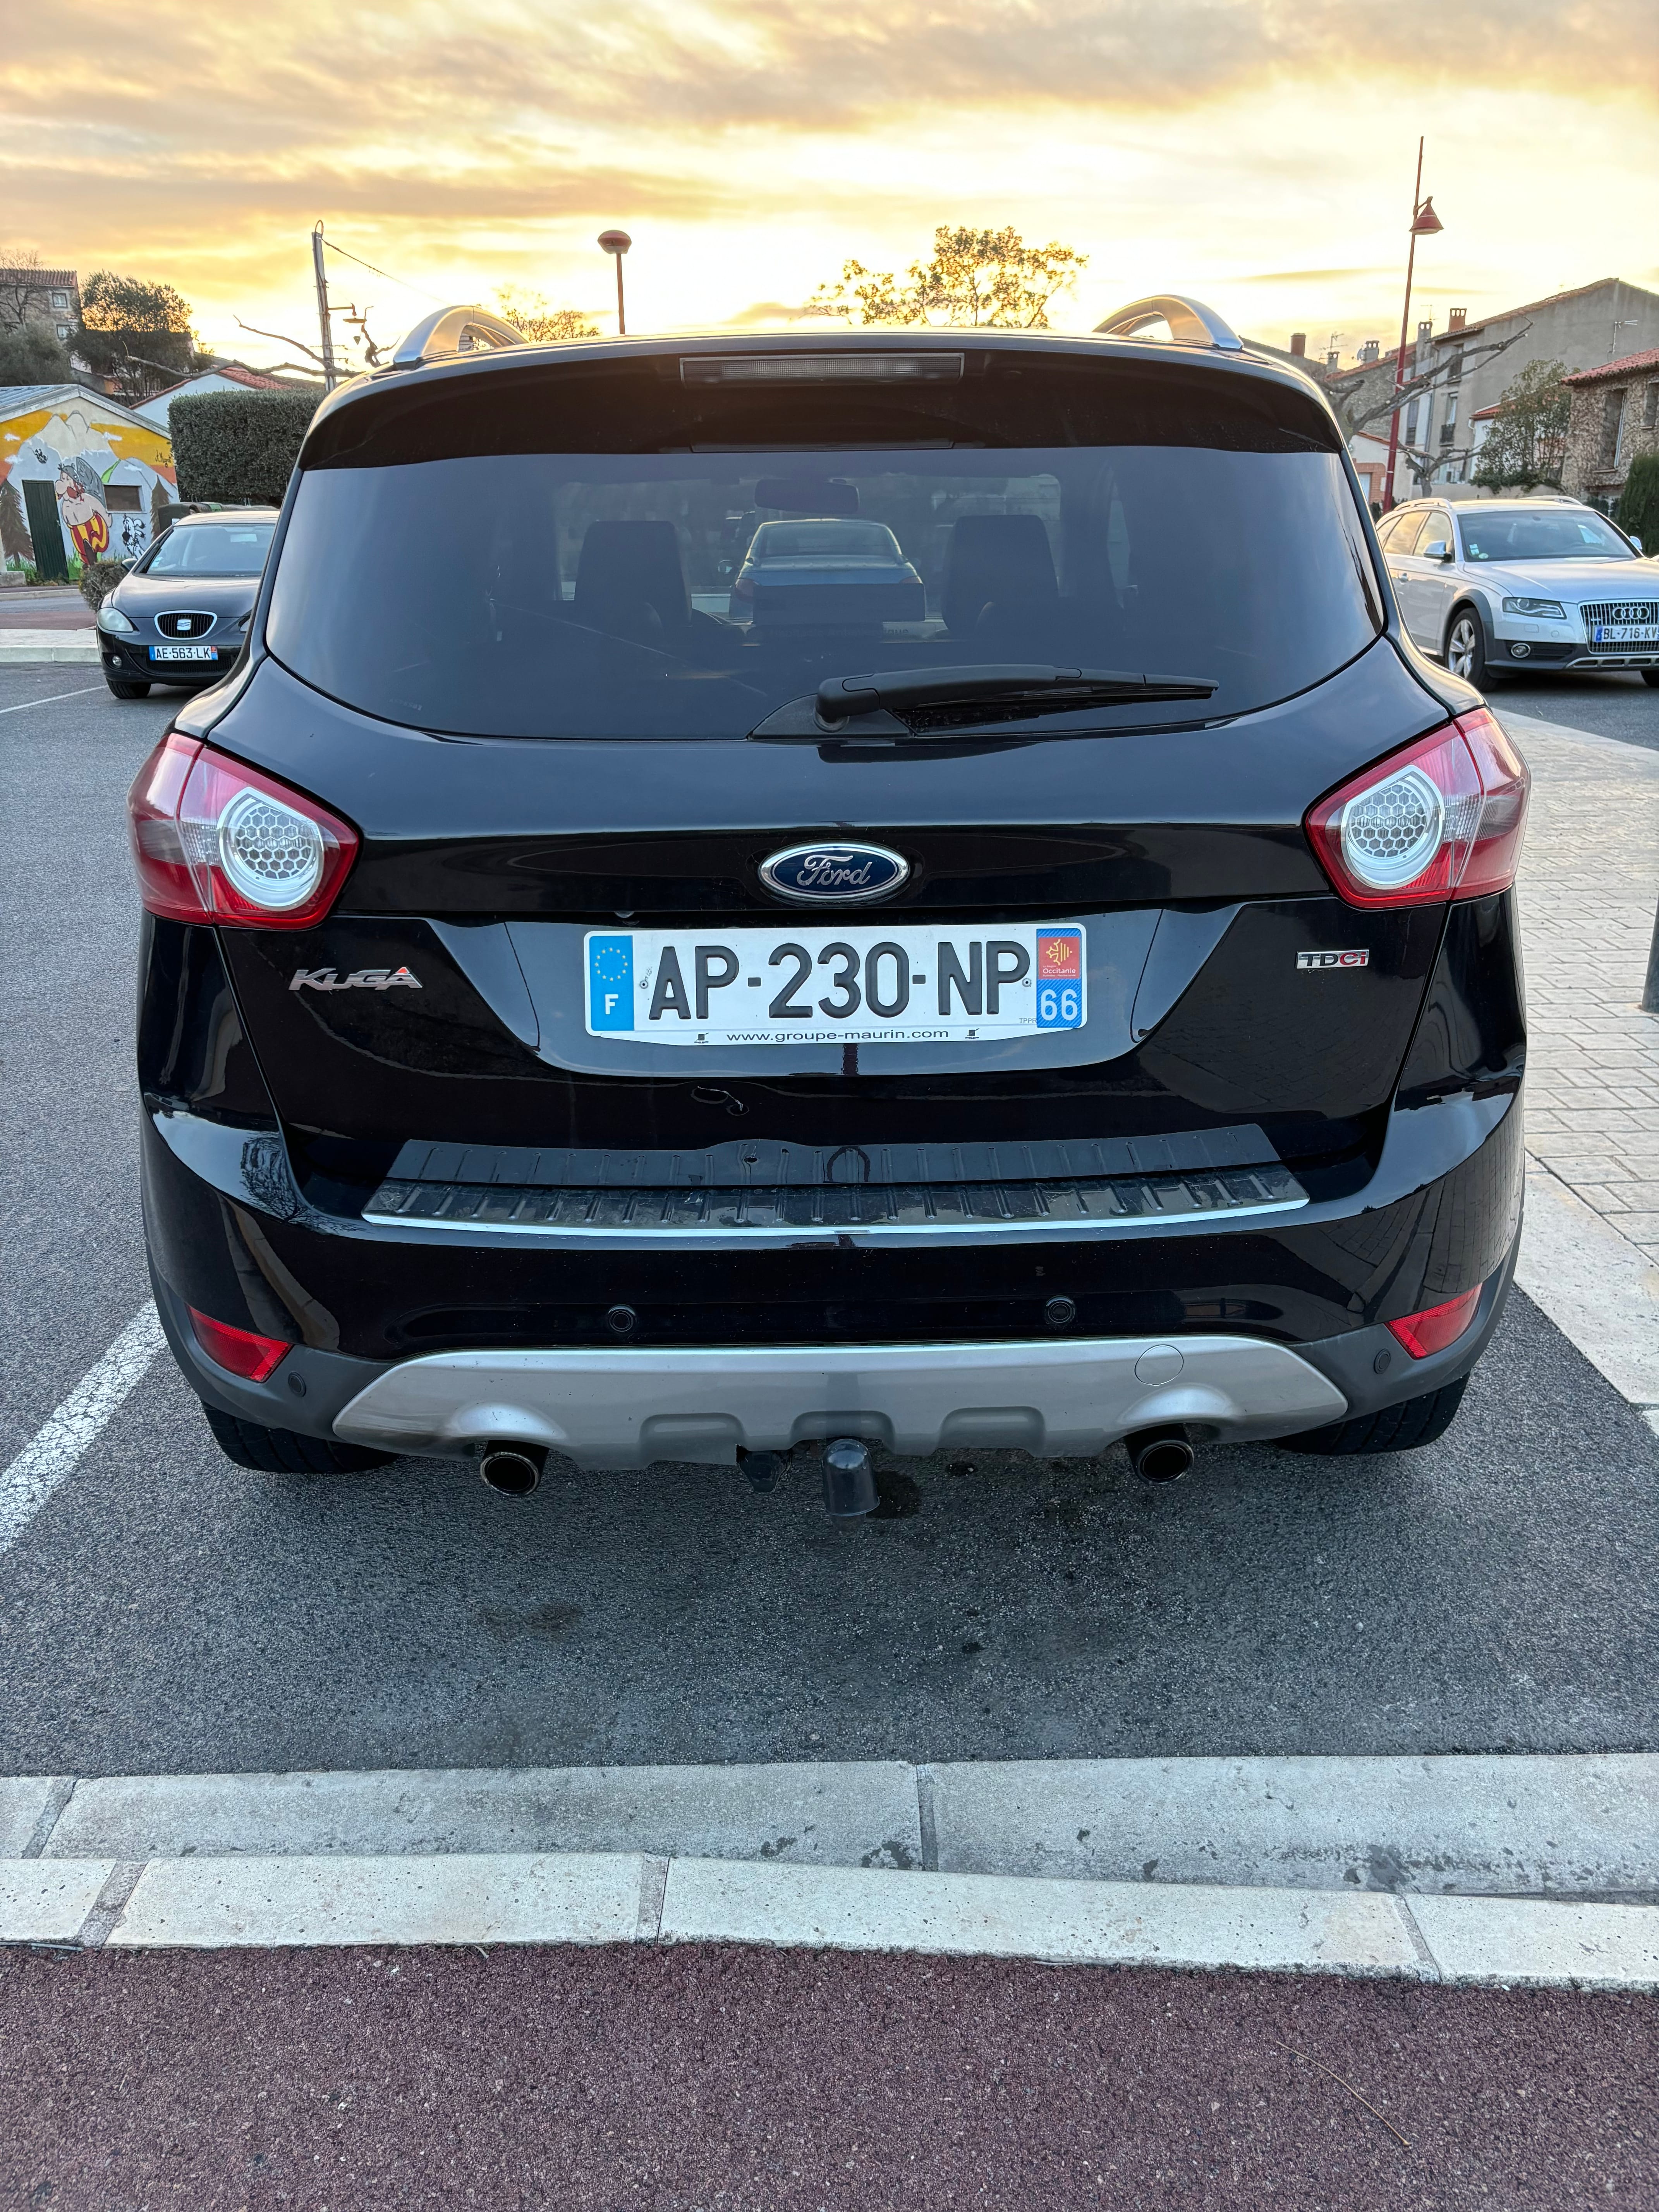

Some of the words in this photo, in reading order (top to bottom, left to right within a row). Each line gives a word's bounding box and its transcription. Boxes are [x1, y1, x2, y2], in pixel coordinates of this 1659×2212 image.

[1604, 627, 1657, 639] BL-716-KV
[156, 647, 210, 659] AE-563-LK
[796, 855, 872, 886] Ford
[1301, 952, 1366, 967] TDCi
[289, 967, 422, 990] KUGA
[648, 941, 1030, 1020] AP-230-NP
[605, 994, 619, 1015] F
[1041, 989, 1078, 1020] 66
[726, 1030, 949, 1042] www.groupe-maurin.com
